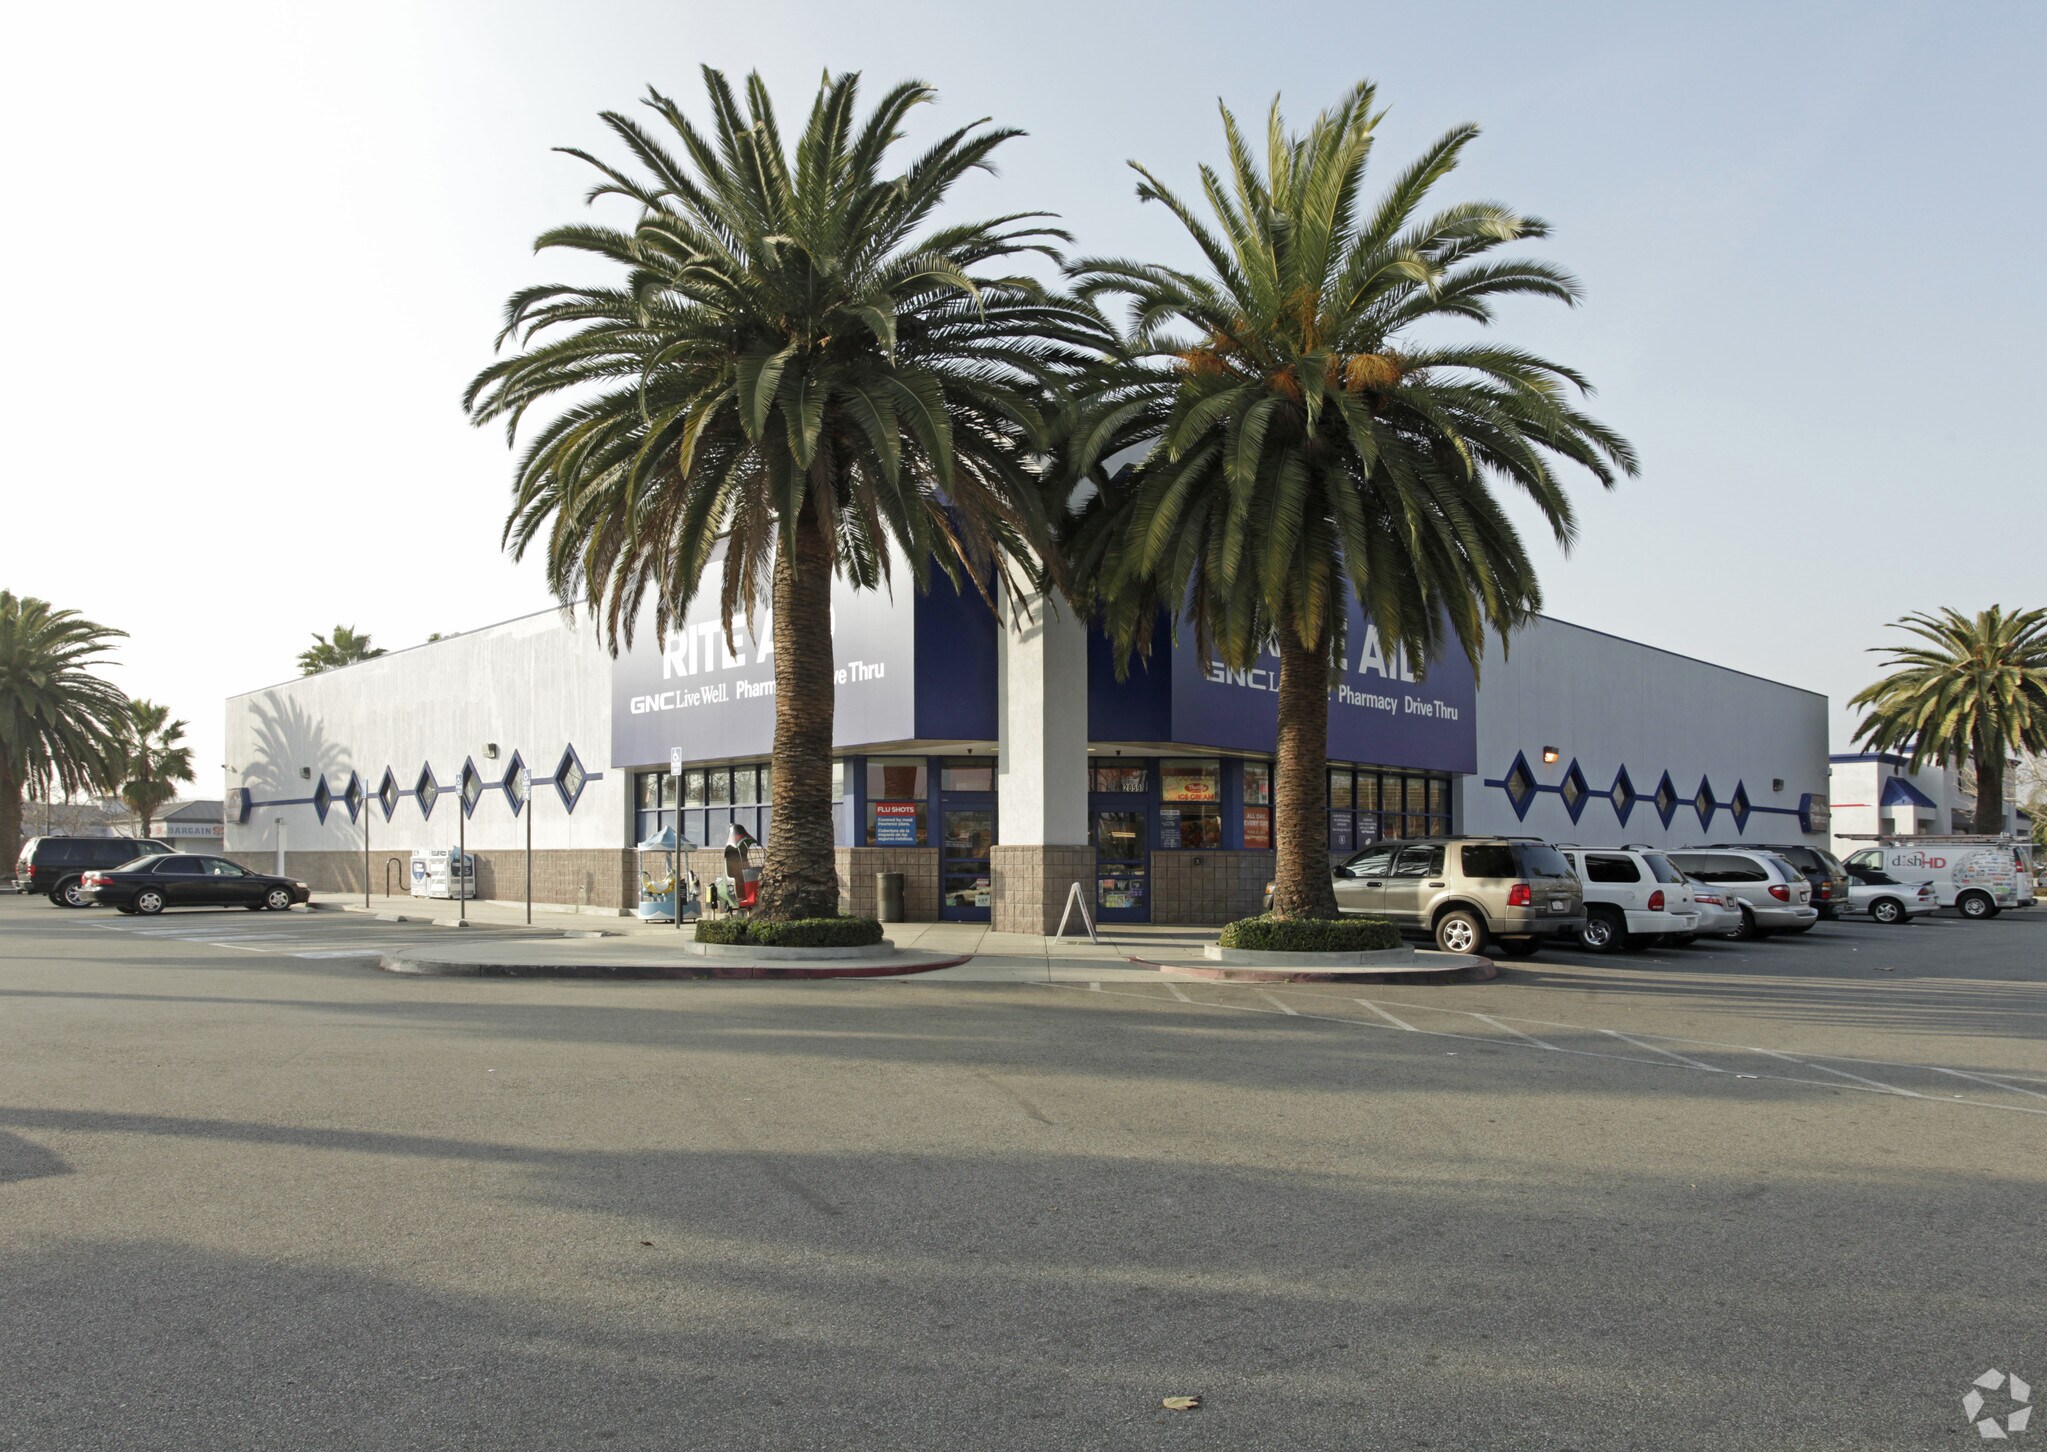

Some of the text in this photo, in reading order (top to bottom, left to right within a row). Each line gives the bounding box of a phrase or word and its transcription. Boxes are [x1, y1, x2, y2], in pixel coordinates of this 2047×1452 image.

[663, 612, 746, 680] RITE
[848, 660, 885, 682] Thru
[630, 691, 675, 714] GNC
[736, 679, 777, 700] Pharm
[1204, 660, 1267, 690] GNC
[1338, 684, 1398, 716] Pharmacy
[1404, 695, 1433, 717] Drive
[1433, 700, 1458, 720] Thru
[168, 826, 212, 835] BARGAIN
